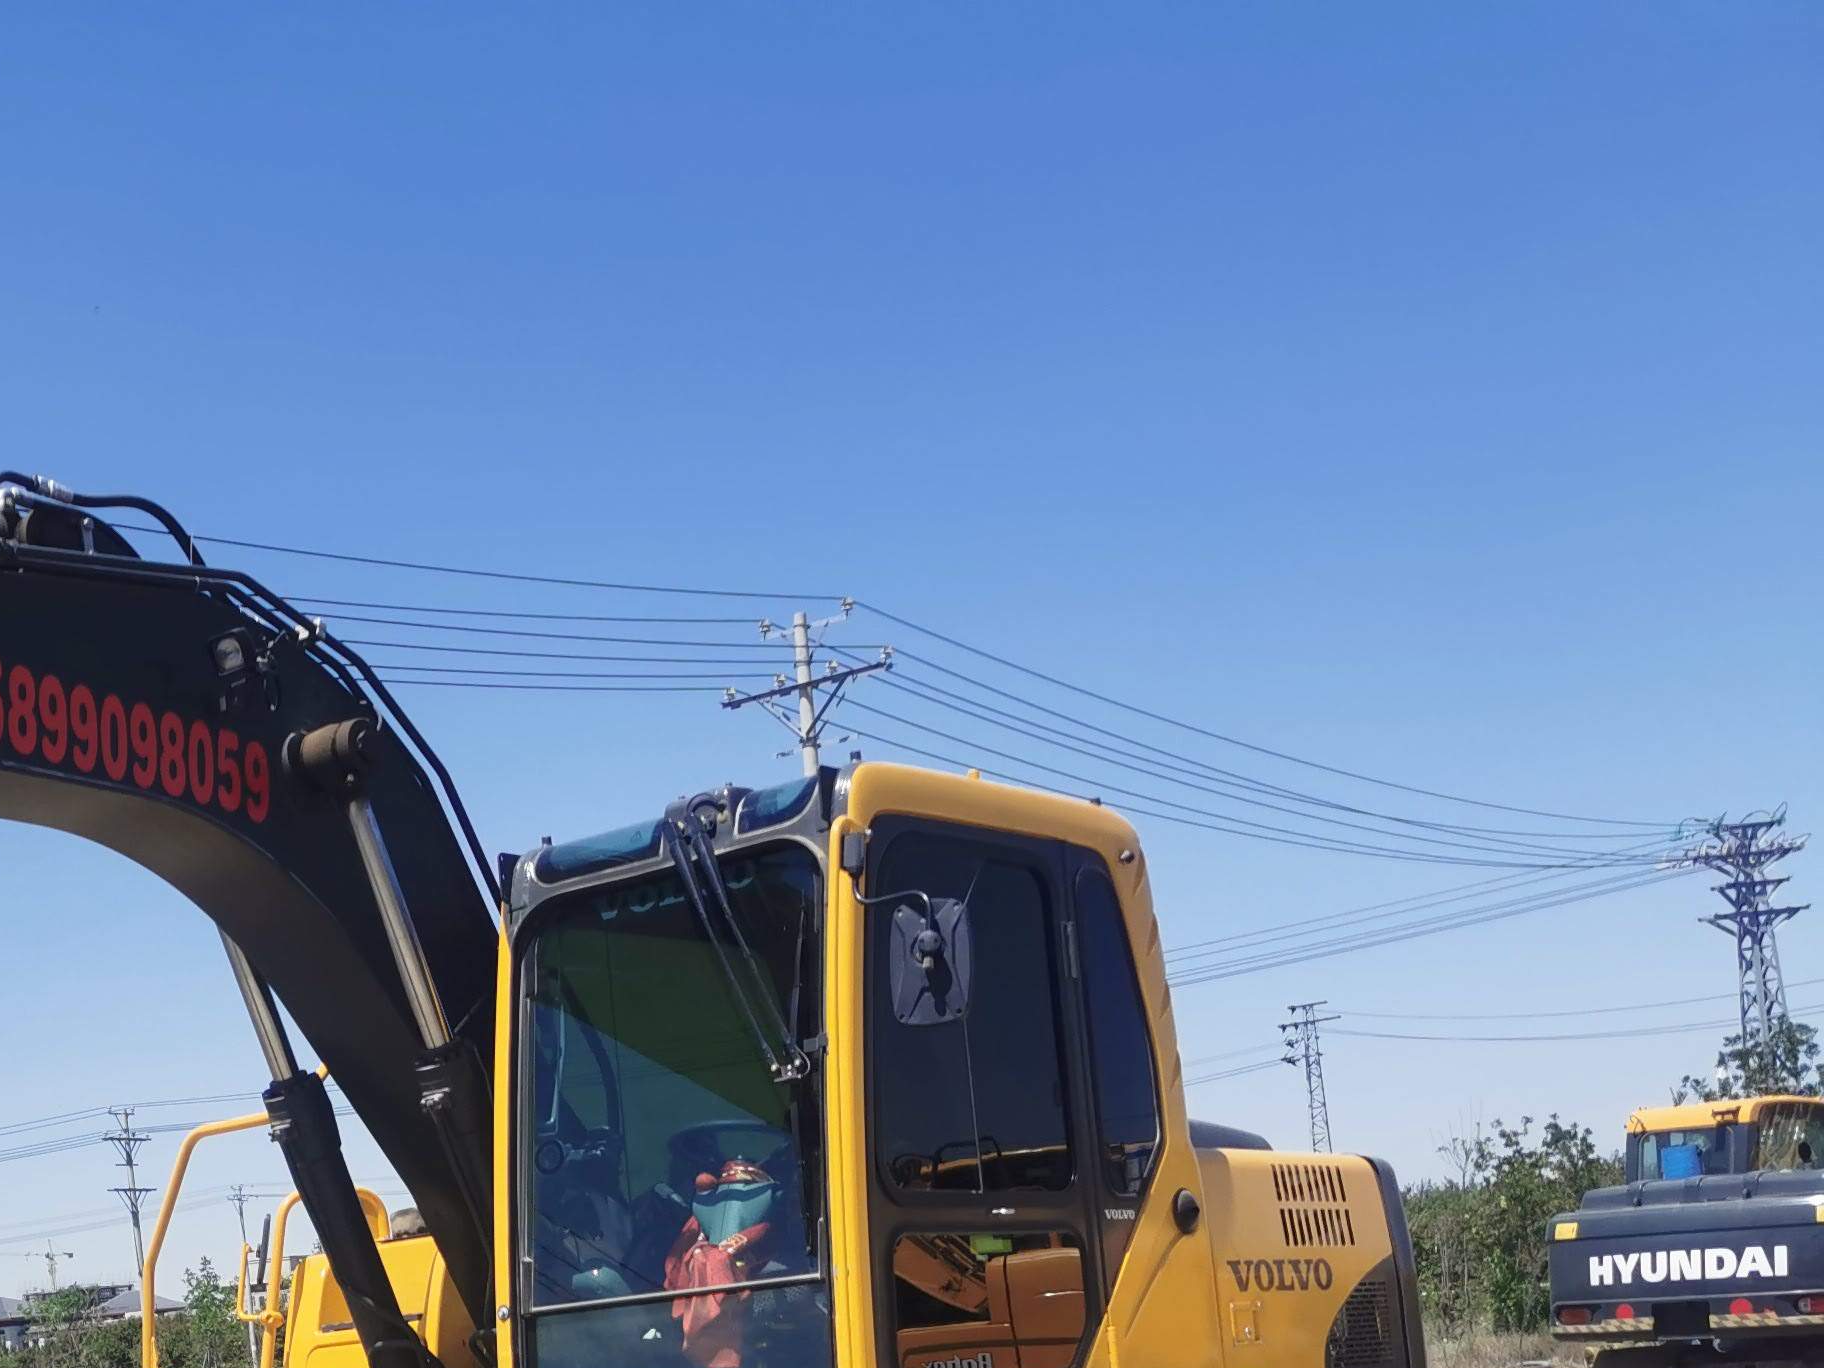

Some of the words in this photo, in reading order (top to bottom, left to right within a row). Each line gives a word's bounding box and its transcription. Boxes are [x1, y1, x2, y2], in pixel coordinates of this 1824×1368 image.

[1104, 1208, 1136, 1220] VOLVO
[1226, 1258, 1334, 1293] VOLVO
[1589, 1245, 1789, 1287] HYUNDAI
